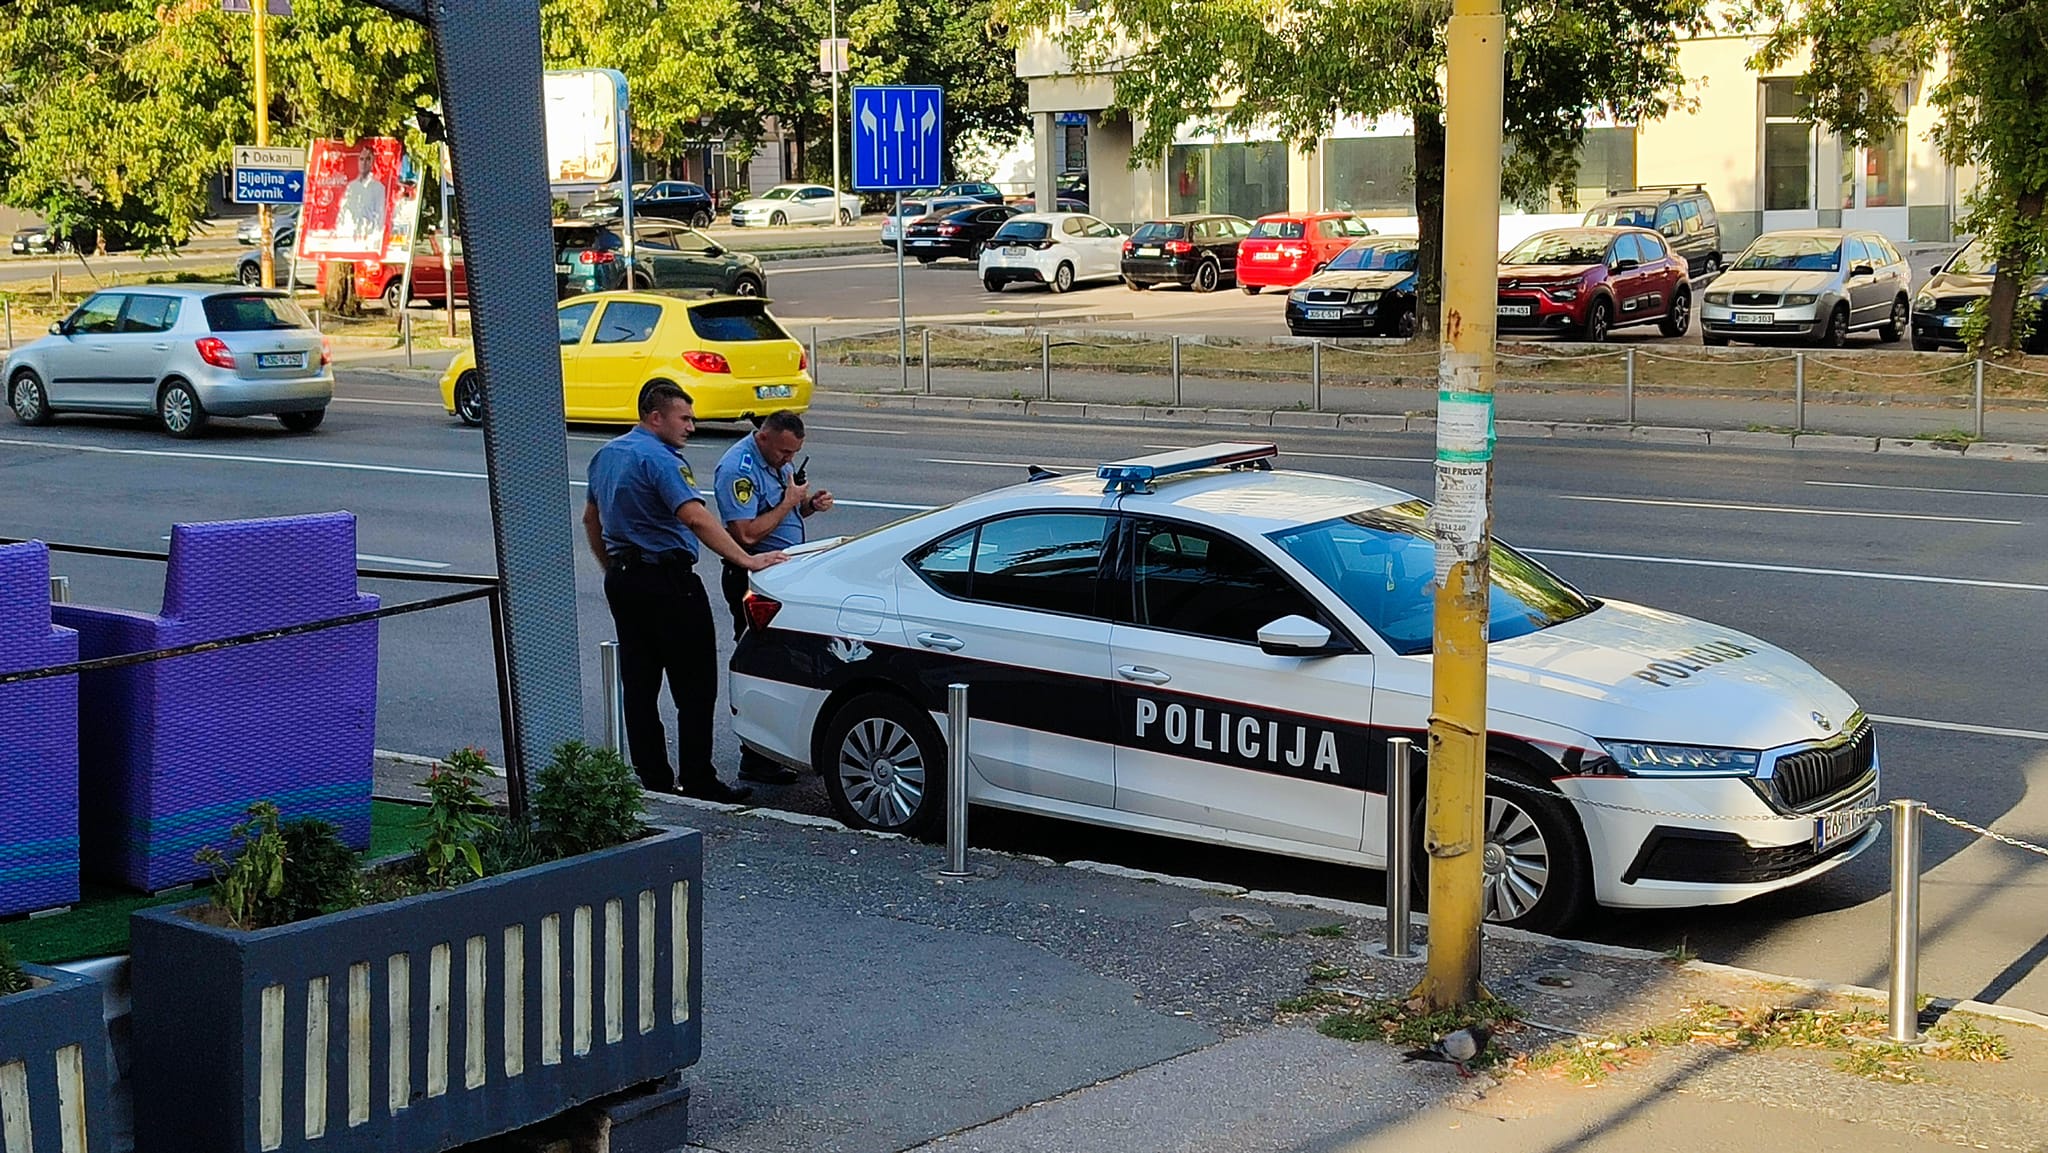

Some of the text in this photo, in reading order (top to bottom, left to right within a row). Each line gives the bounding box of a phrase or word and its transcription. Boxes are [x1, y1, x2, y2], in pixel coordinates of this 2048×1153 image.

[253, 152, 293, 165] Dokanj
[238, 171, 285, 187] Bijeljina
[238, 186, 284, 199] Zvornik
[1452, 467, 1483, 476] PREVOZ
[1631, 641, 1757, 687] POLICIJA
[1135, 697, 1341, 775] POLICIJA
